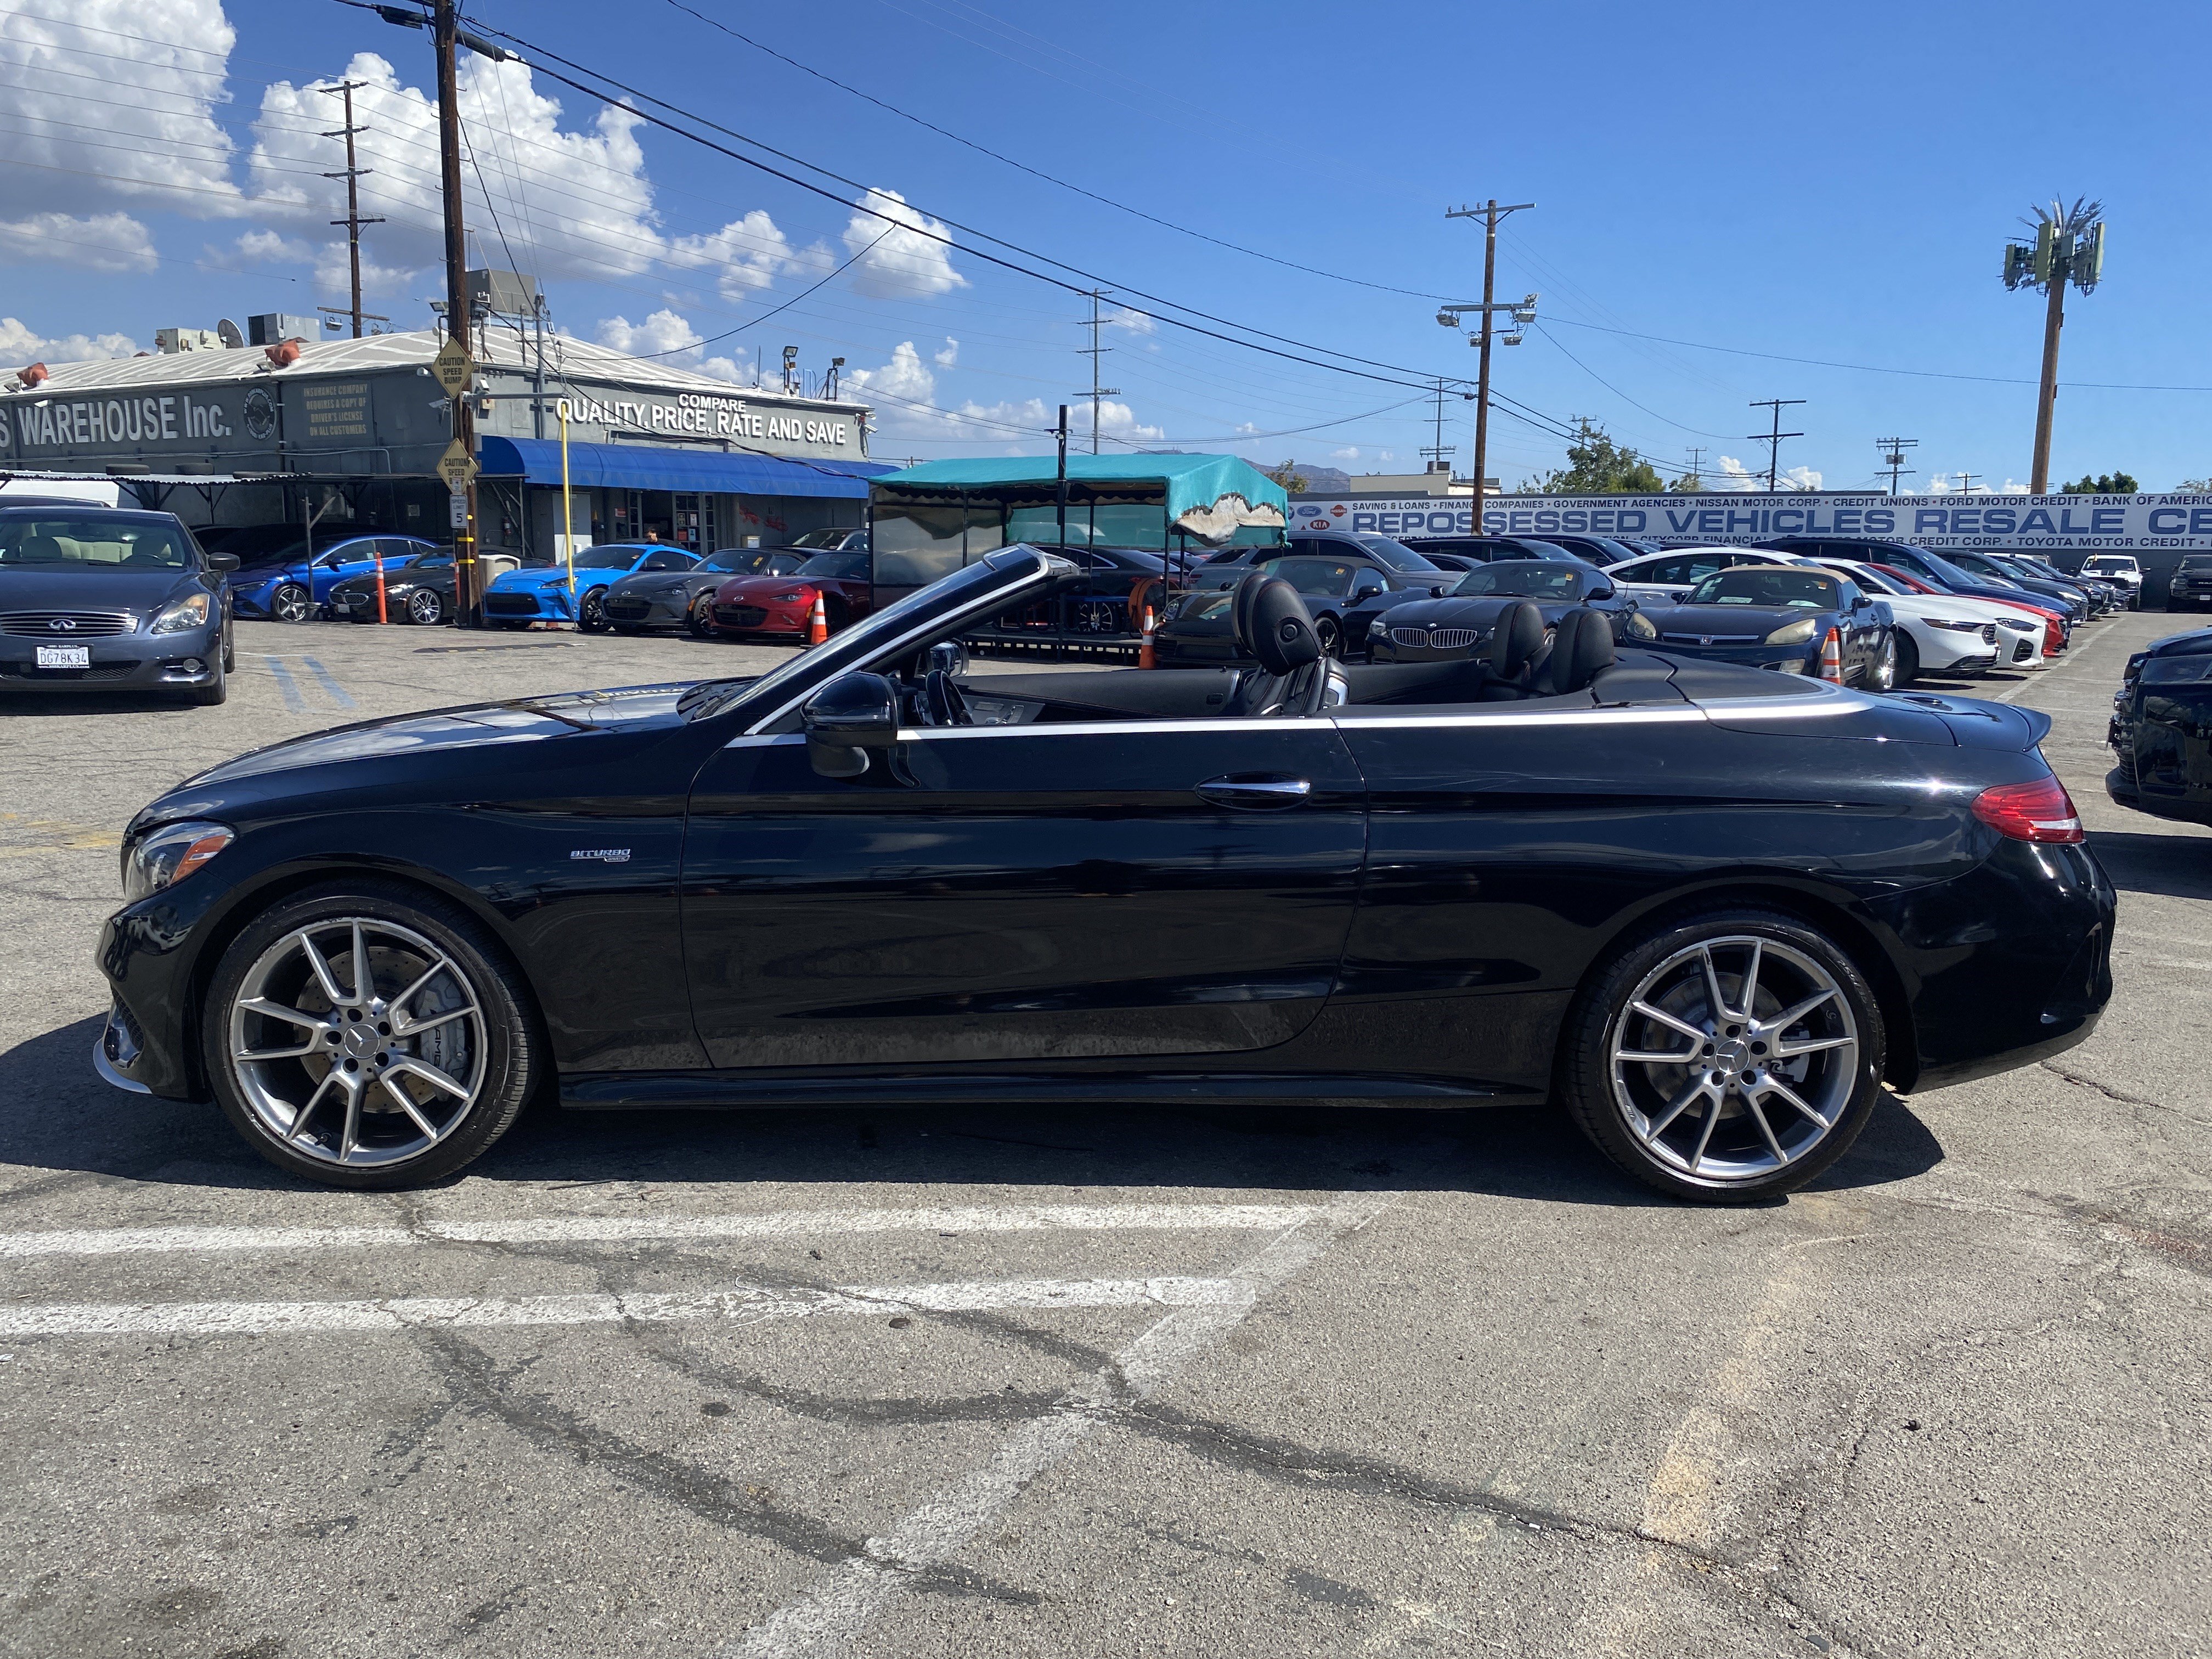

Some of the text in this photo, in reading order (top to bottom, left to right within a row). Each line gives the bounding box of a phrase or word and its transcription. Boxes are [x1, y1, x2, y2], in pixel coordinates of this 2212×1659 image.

[439, 357, 465, 366] CAUTION
[304, 384, 368, 397] INSURANCE COMPANY
[306, 397, 366, 410] REQUIRES A COPY OF
[678, 393, 747, 413] COMPARE
[18, 397, 179, 445] WAREHOUSE
[183, 396, 232, 438] Inc.
[311, 411, 363, 423] DRIVER'S LICENSE
[556, 397, 846, 444] QUALITY, PRICE, RATE AND SAVE
[309, 424, 367, 436] ON ALL CUSTOMERS
[445, 458, 468, 466] CAUTION
[1398, 501, 1430, 510] LOANS
[1439, 501, 1474, 509] FINANC
[1485, 500, 1544, 509] COMPANIES
[1554, 499, 1628, 508] GOVERNMENT
[1631, 499, 1685, 507] AGENCIES
[1696, 499, 1739, 507] NISSAN
[1788, 498, 1821, 506] CORP.
[1833, 498, 1876, 506] CREDIT
[1881, 498, 1928, 506] UNIONS
[1940, 497, 1974, 506] FORD
[1978, 497, 2027, 506] MOTOR
[2031, 496, 2081, 505] CREDIT
[2092, 496, 2131, 505] BANK
[2137, 496, 2155, 505] OF
[456, 513, 462, 522] 5
[1352, 510, 1646, 533] REPOSSESSED
[1665, 510, 1895, 533] VEHICLES
[1914, 509, 2125, 534] RESALE
[1910, 537, 1958, 545] CREDIT
[1962, 537, 2002, 546] CORP.
[2017, 537, 2073, 546] TOYOTA
[2078, 538, 2134, 546] MOTOR
[2140, 538, 2196, 547] CREDIT
[40, 653, 86, 663] DG78K34
[570, 849, 630, 857] BITURBO
